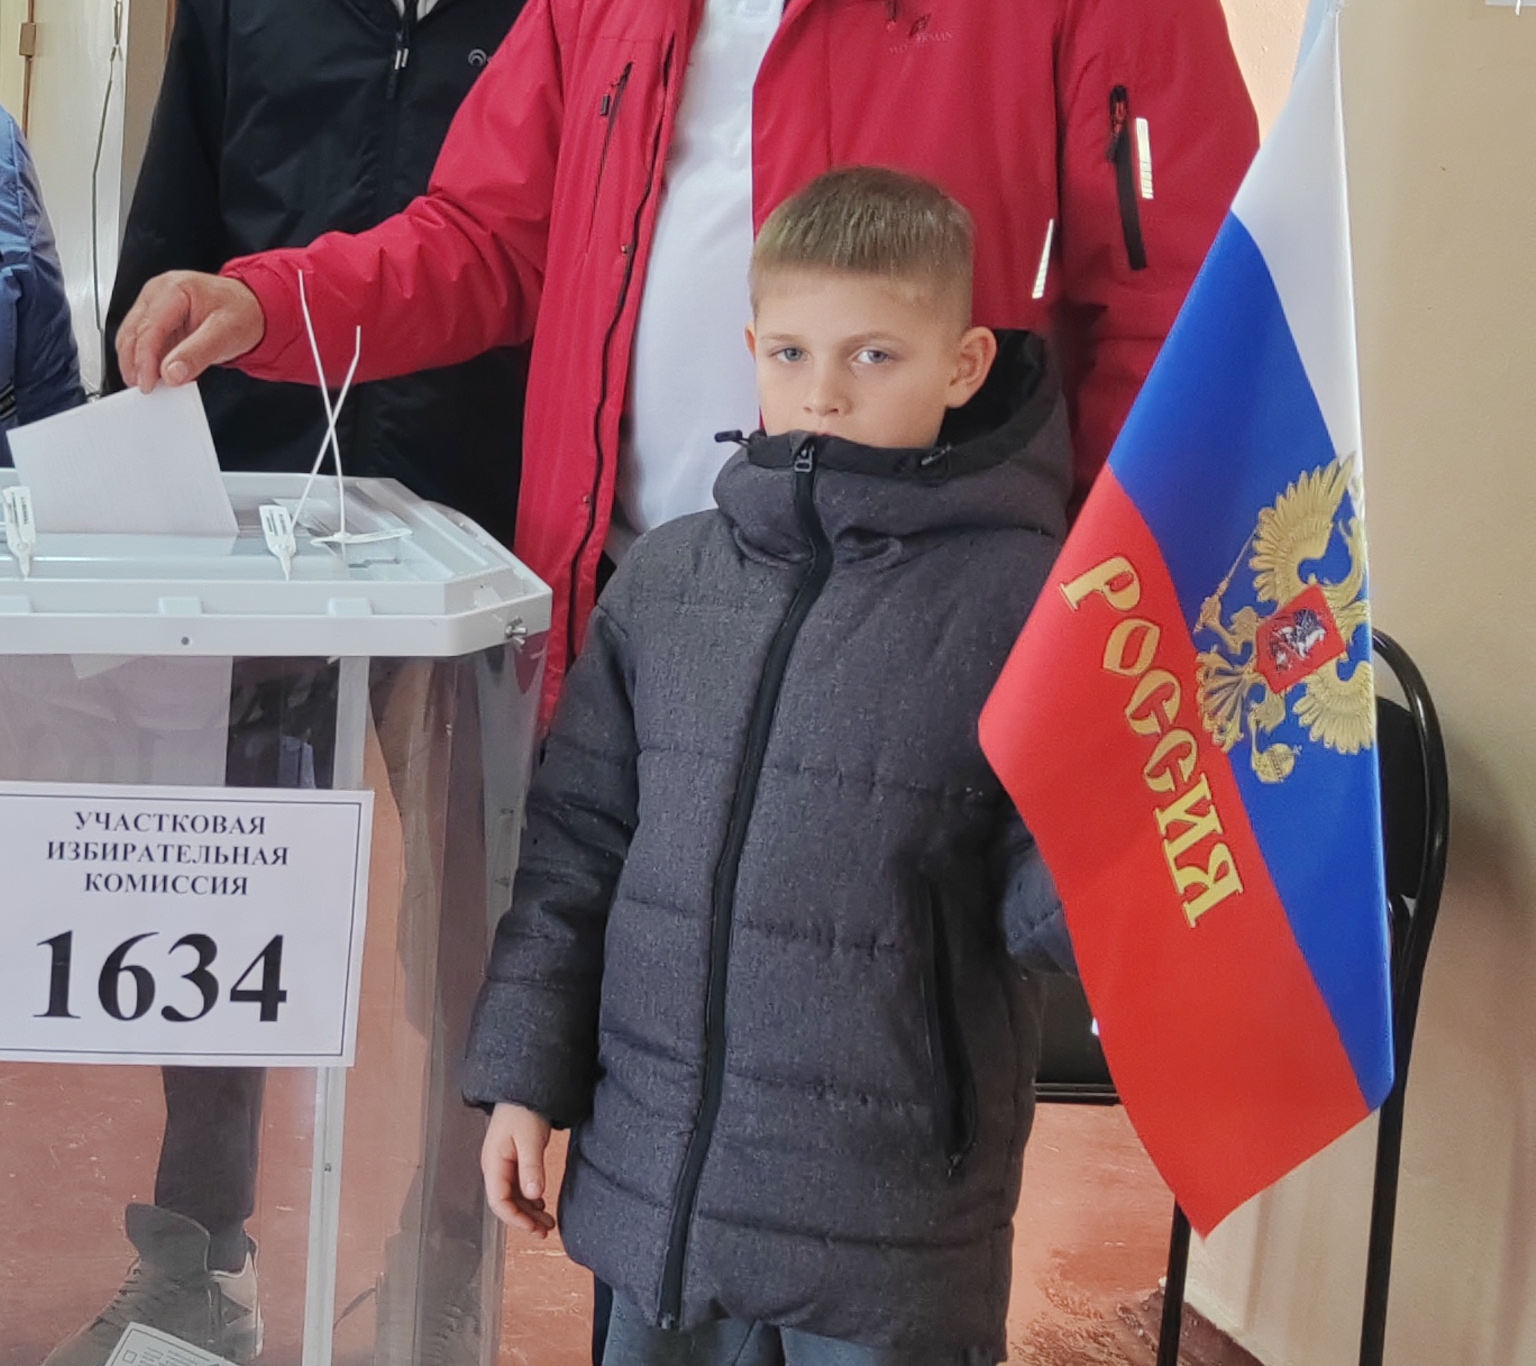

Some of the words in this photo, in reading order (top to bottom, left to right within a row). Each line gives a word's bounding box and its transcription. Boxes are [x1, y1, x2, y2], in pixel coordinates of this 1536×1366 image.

[1059, 555, 1244, 929] РОССИЯ
[74, 811, 267, 835] УЧАСТКОВАЯ
[47, 841, 290, 866] ИЗБИРАТЕЛЬНАЯ
[84, 873, 249, 896] КОМИССИЯ
[32, 929, 288, 1024] 1634
